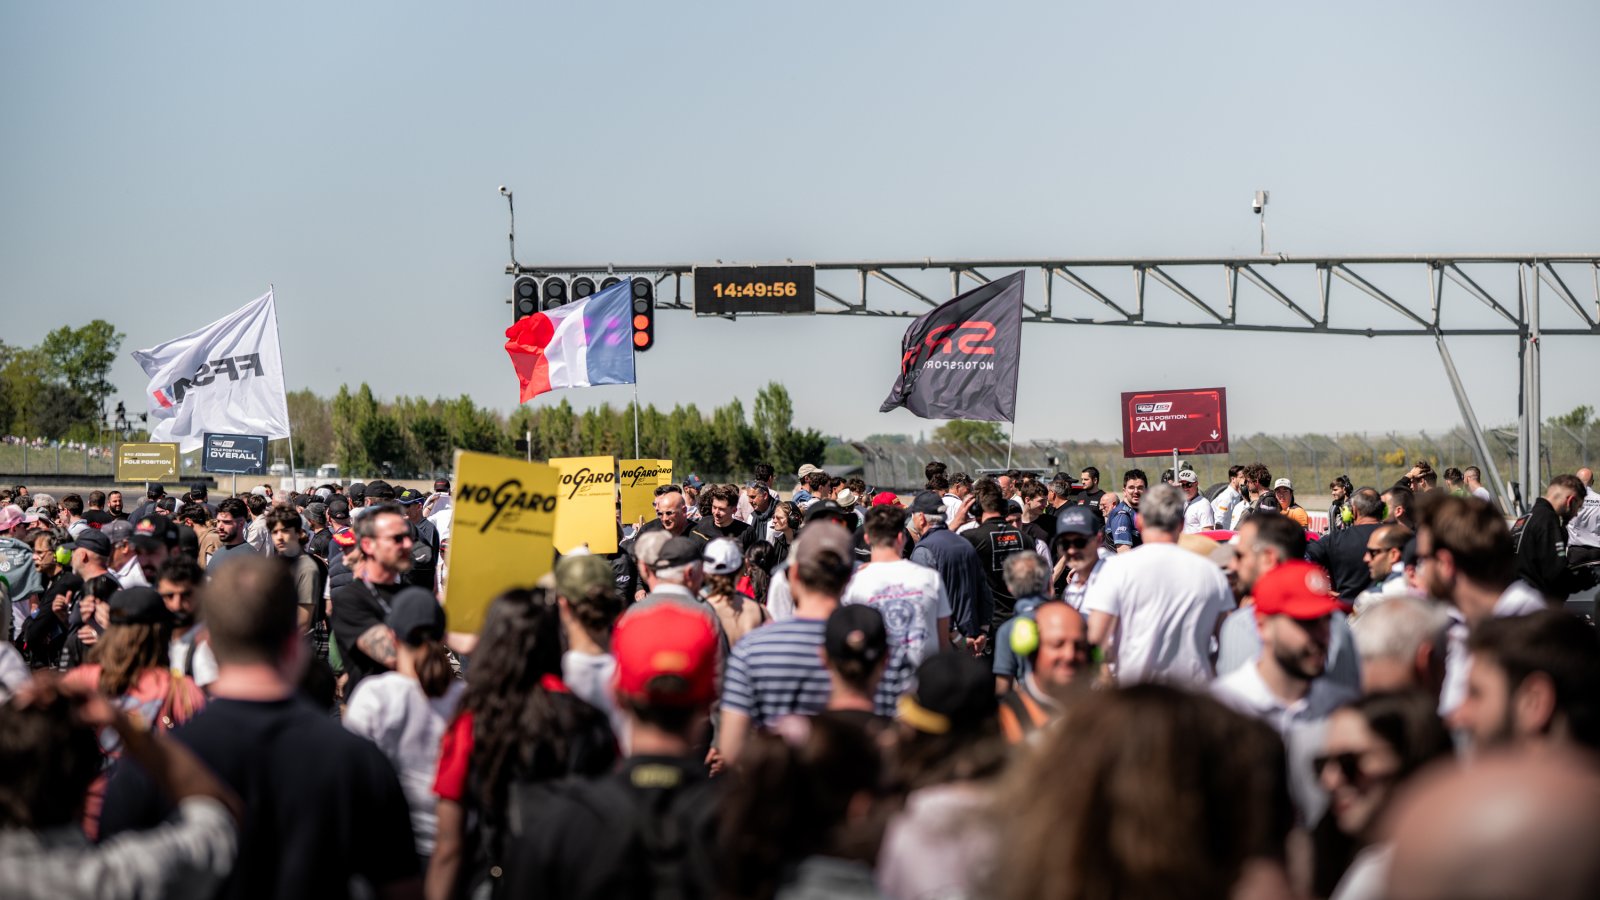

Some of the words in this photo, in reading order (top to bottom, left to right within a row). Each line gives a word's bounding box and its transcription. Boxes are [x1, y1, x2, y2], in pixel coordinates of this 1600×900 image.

[713, 282, 797, 297] 14:49:56
[1136, 421, 1167, 432] AM
[210, 451, 257, 460] OVERALL
[621, 465, 658, 488] NOGARO
[456, 479, 557, 533] NOGARO
